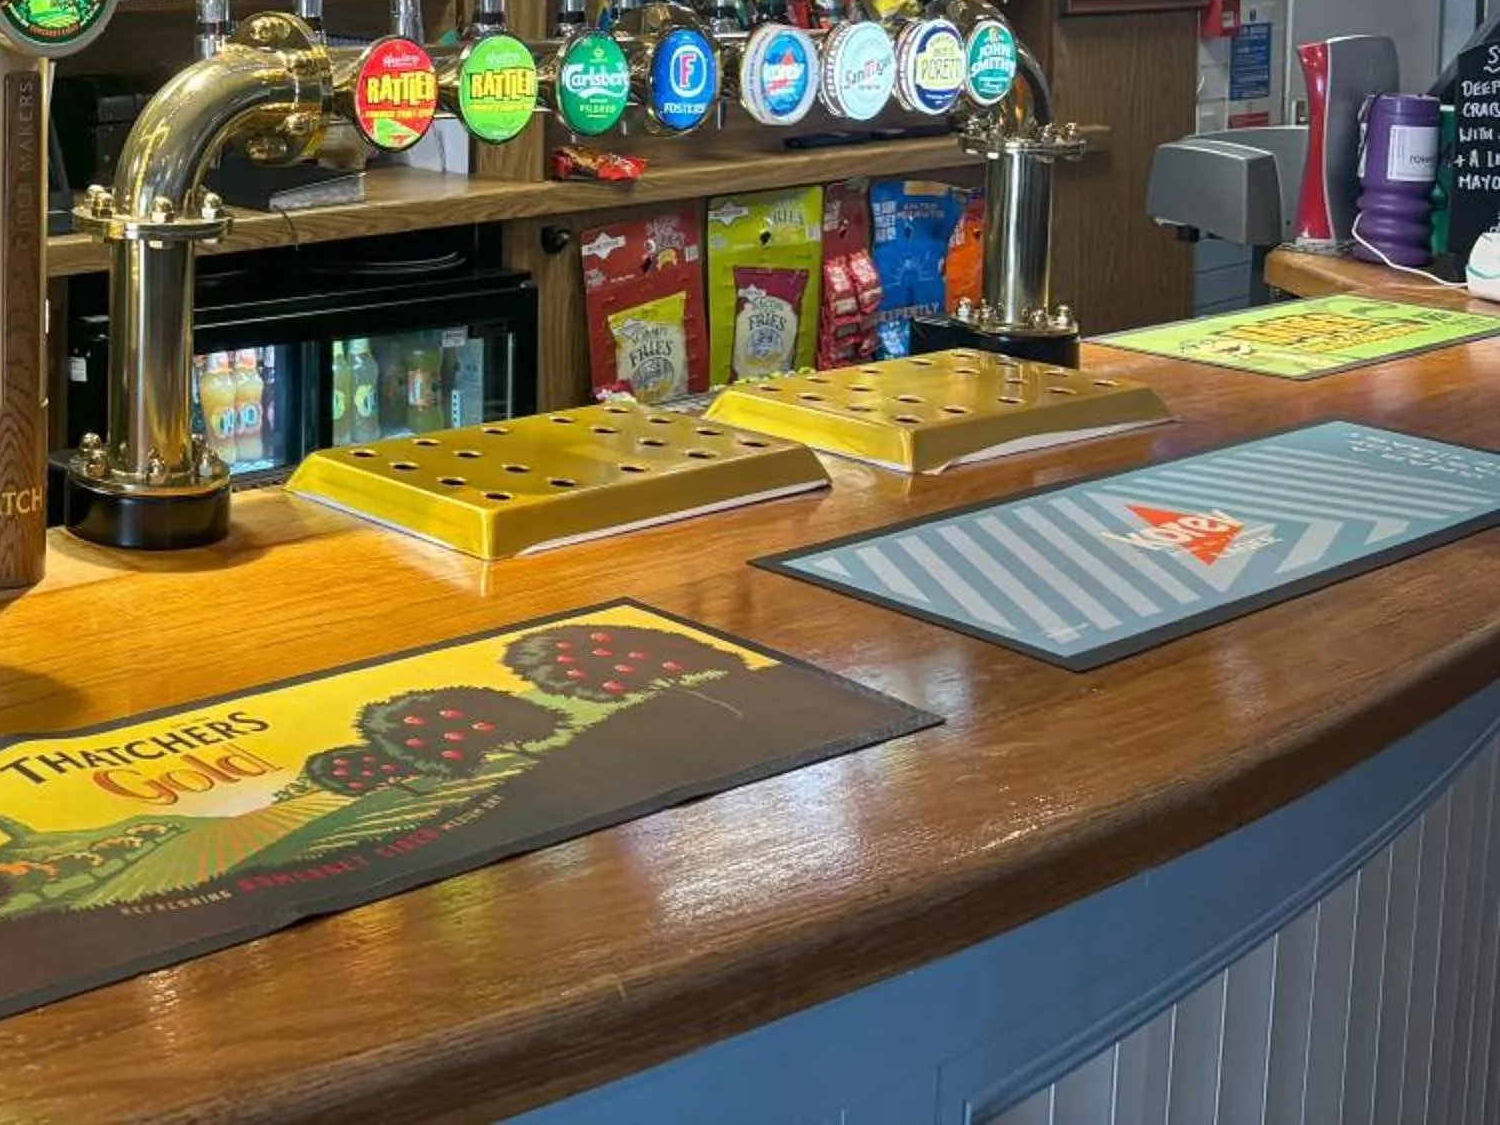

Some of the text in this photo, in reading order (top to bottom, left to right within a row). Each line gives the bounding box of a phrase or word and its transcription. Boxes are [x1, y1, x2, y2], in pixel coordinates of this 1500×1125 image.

[747, 314, 787, 332] FRIES
[629, 338, 672, 368] FRIES
[92, 743, 288, 807] Gold
